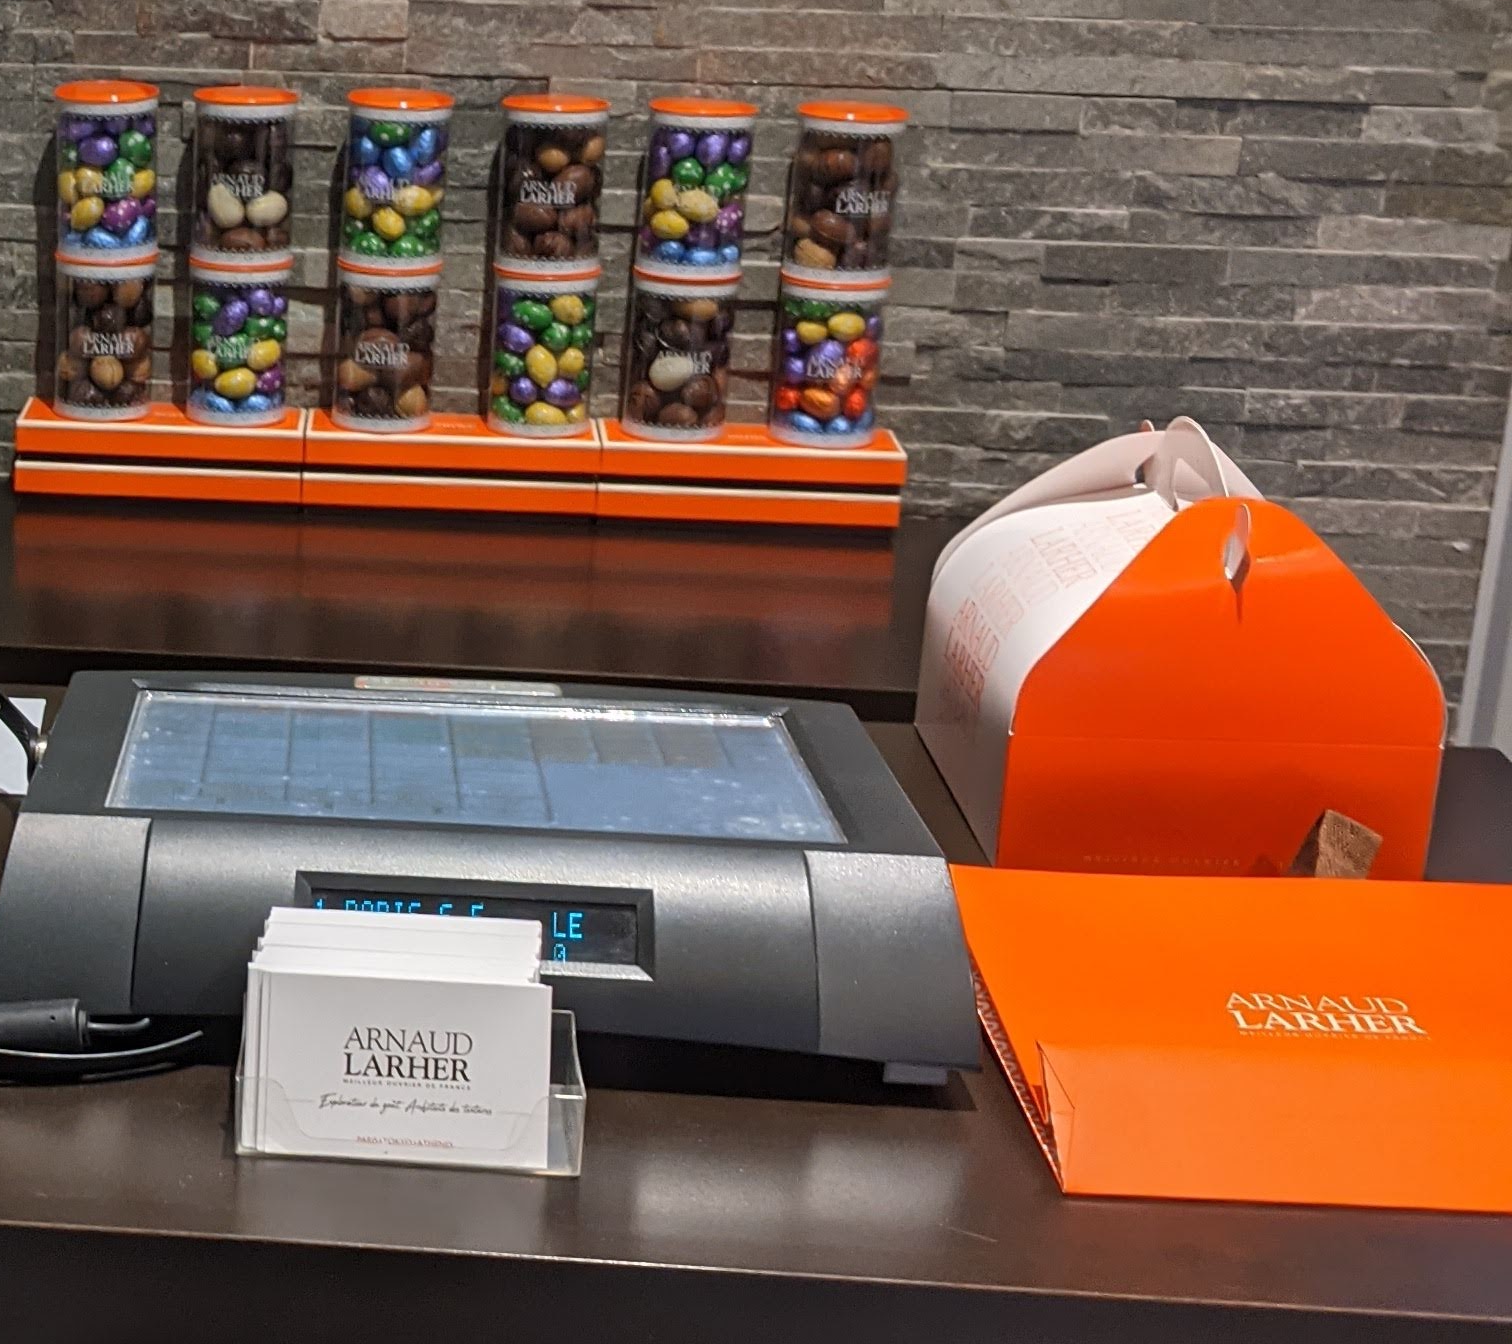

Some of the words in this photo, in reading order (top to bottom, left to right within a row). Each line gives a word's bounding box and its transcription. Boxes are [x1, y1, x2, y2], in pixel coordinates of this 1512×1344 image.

[520, 190, 575, 205] LARHER
[521, 180, 577, 193] ARNAUD
[82, 342, 135, 355] LARHER
[355, 351, 409, 366] LARHER
[552, 911, 584, 939] LE
[1226, 992, 1409, 1014] ARNAUD
[1227, 1010, 1428, 1035] LARHER
[343, 1026, 473, 1056] ARNAUD
[343, 1052, 471, 1082] LARHER
